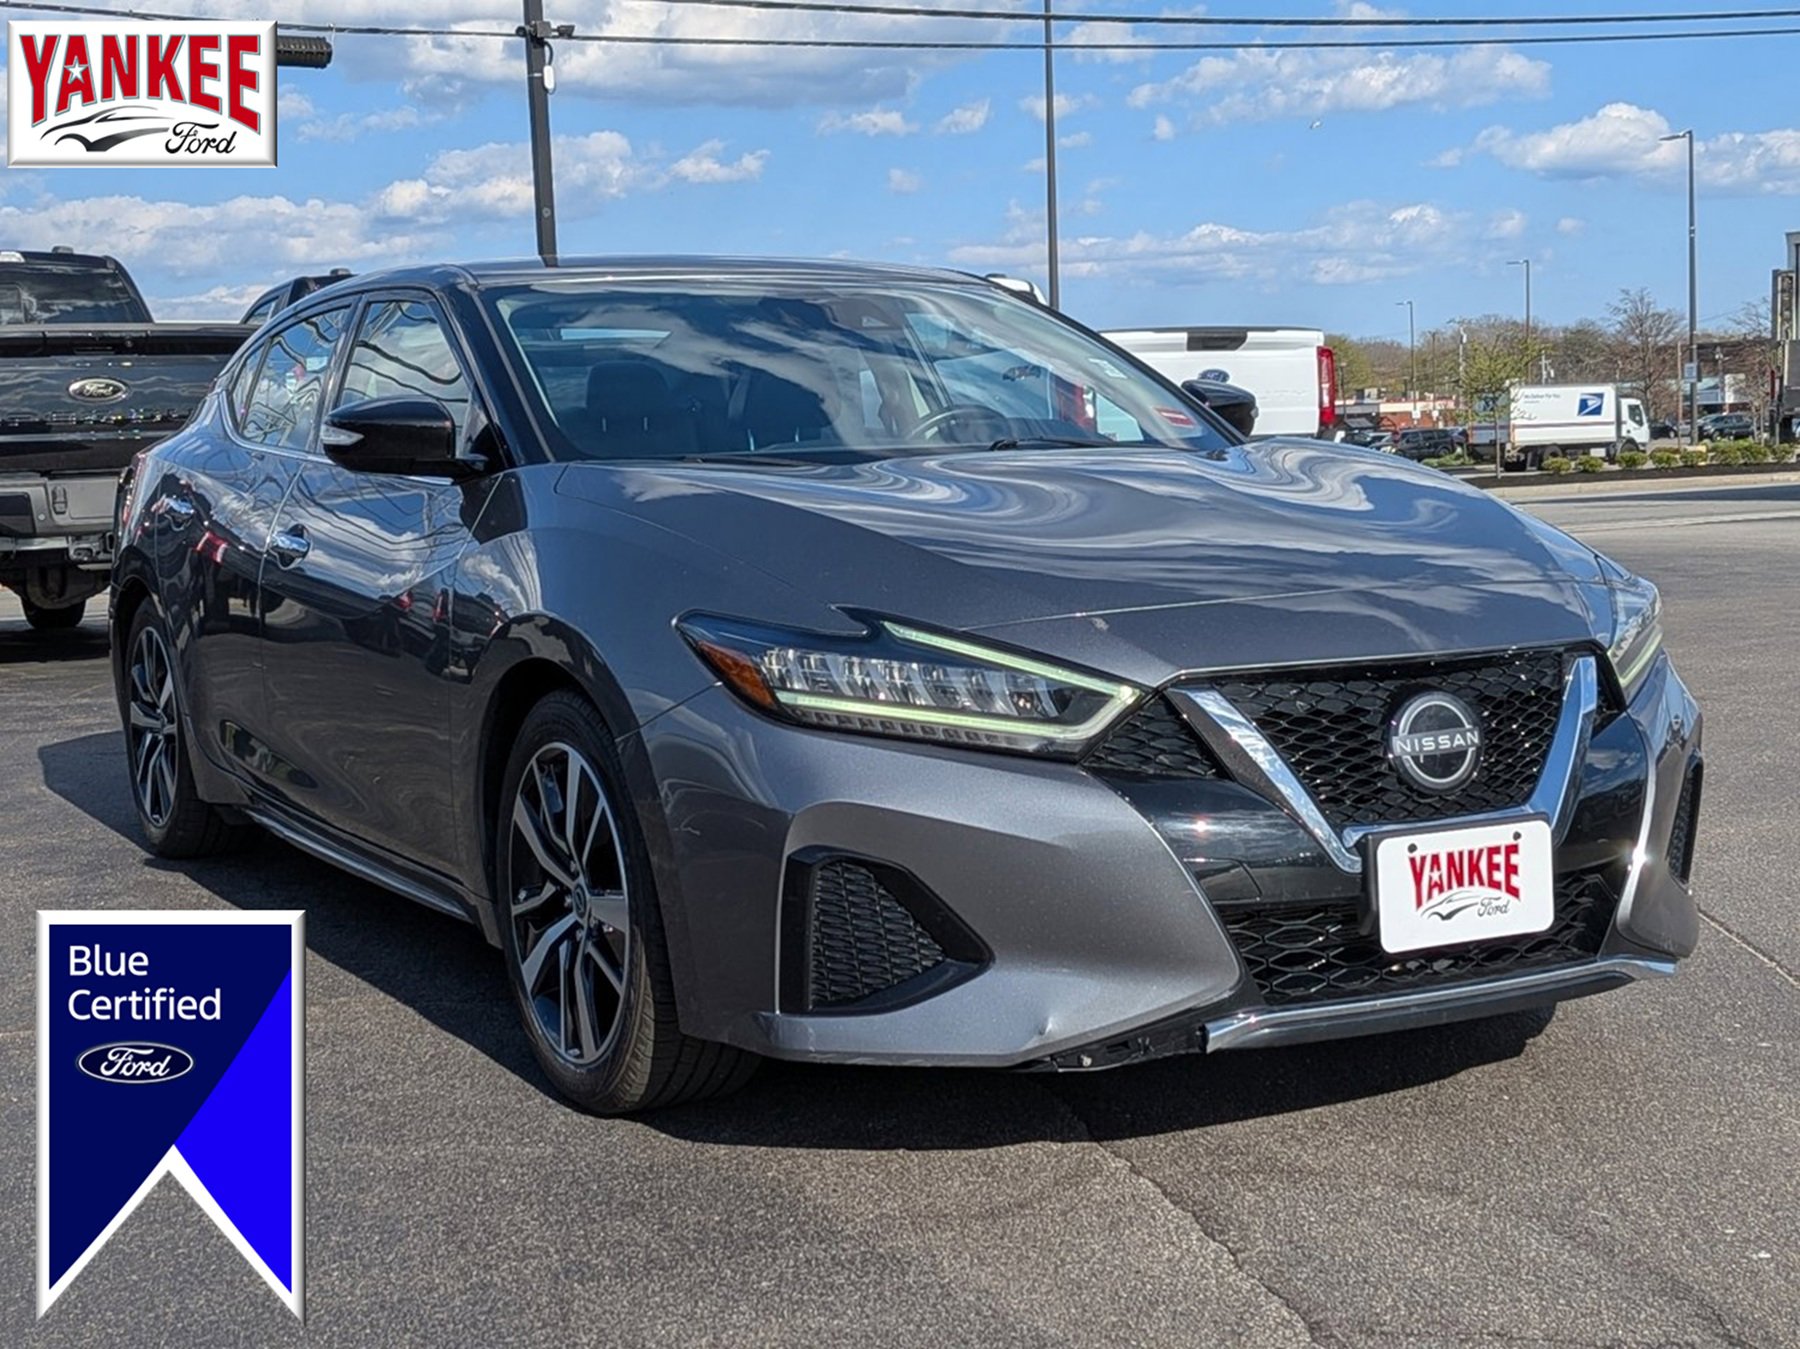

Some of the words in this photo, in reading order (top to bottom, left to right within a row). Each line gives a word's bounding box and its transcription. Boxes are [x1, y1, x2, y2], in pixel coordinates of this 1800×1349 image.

[83, 383, 113, 396] Ford
[1396, 730, 1480, 753] NISSAN
[1408, 843, 1521, 911] YANKEE
[1477, 897, 1510, 917] Ford
